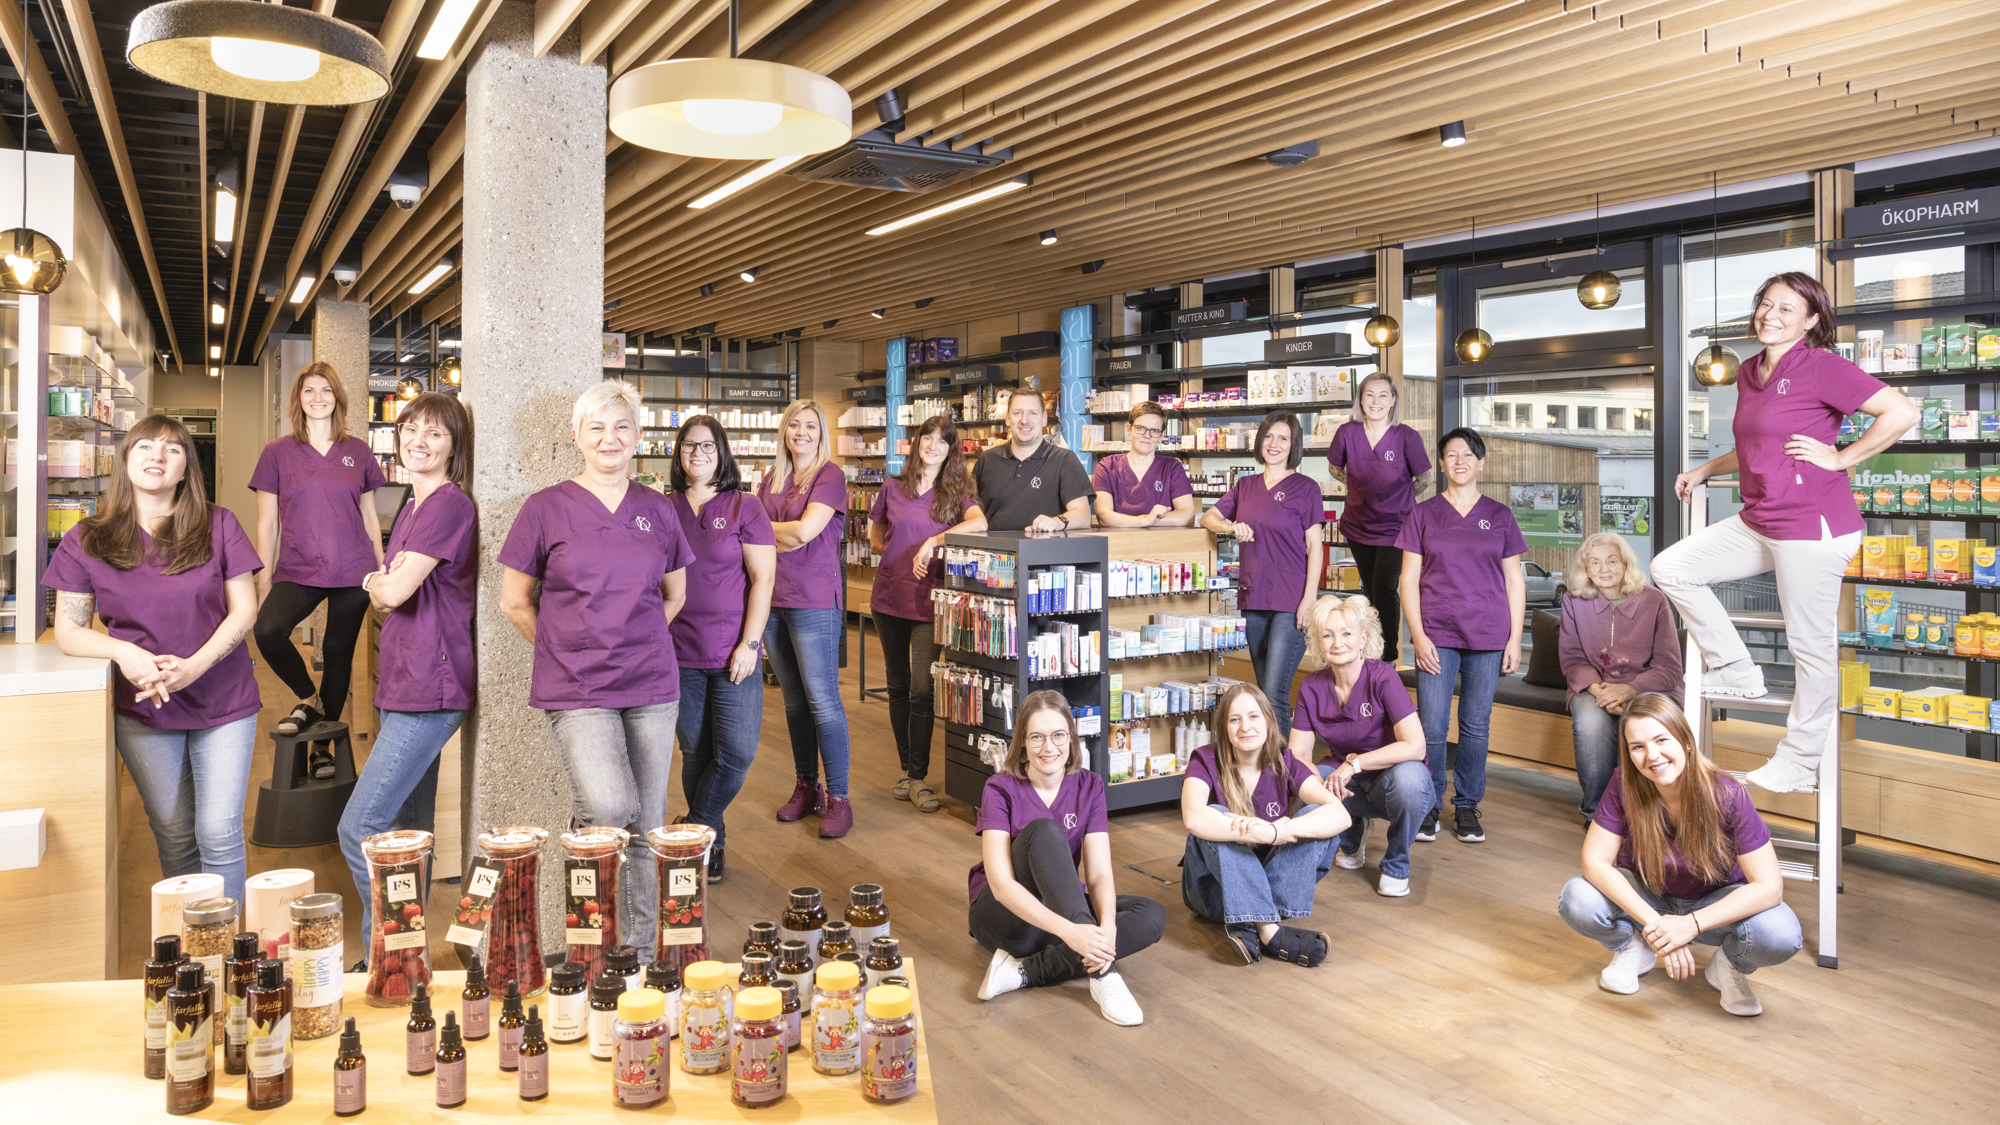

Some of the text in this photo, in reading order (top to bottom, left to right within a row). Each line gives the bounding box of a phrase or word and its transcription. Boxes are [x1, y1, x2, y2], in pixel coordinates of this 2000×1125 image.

[1881, 199, 1979, 226] ÖKOPHARM
[1177, 309, 1225, 324] MUTTER & KIND
[1285, 341, 1313, 353] KINDER
[1109, 360, 1132, 370] FRAUEN
[955, 371, 982, 380] WOHLFÜHLEN
[913, 382, 933, 392] SCHÖNHEIT
[728, 389, 782, 398] SANFT GEPFLEGT
[174, 1003, 205, 1016] farfalla
[252, 1001, 283, 1013] farfalla
